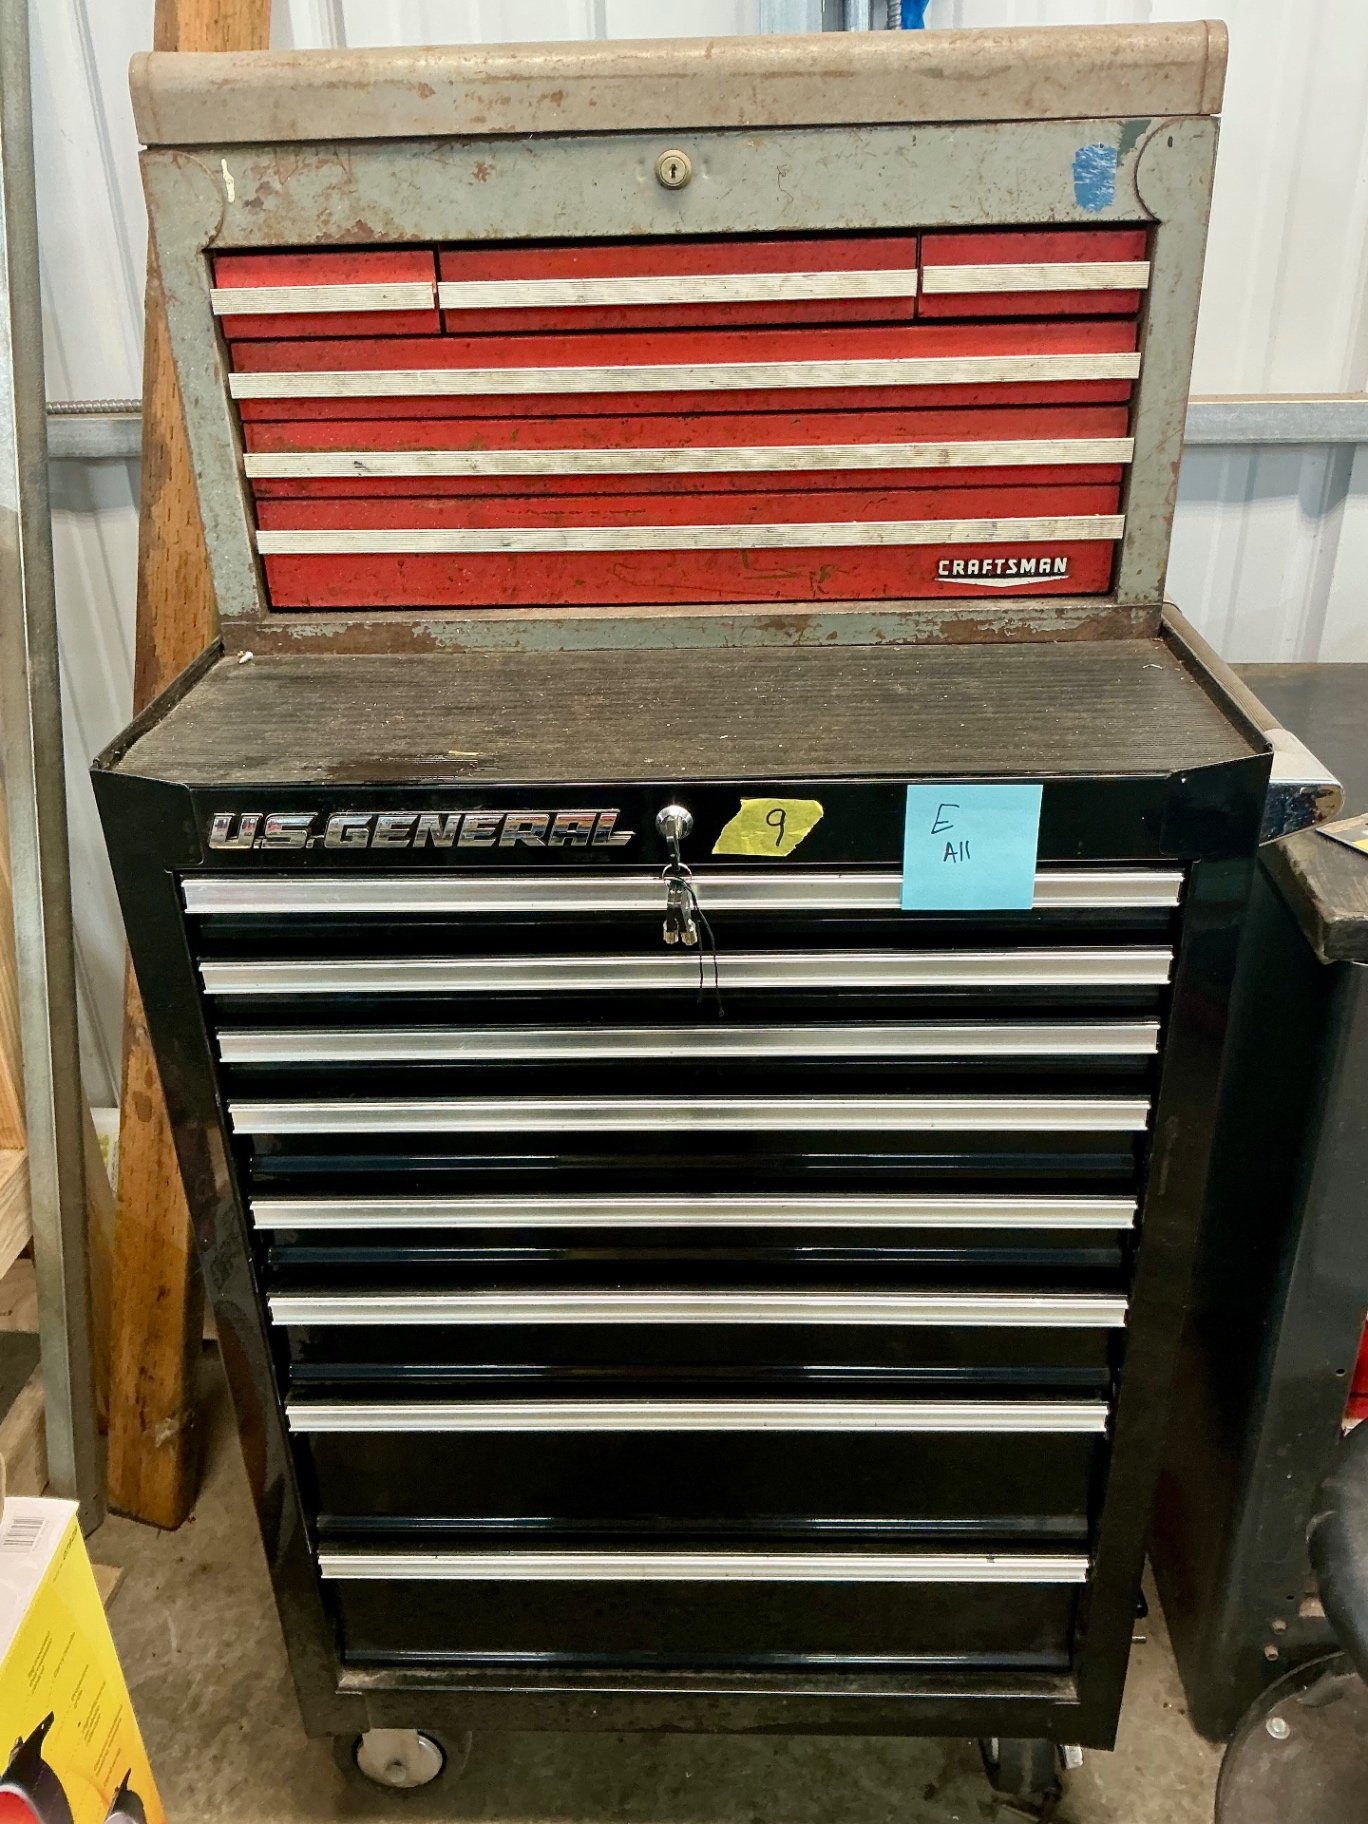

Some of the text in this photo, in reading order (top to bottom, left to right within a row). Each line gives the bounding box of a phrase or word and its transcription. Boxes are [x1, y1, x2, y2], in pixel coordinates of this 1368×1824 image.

[937, 557, 1068, 577] CRAFTSMAN
[765, 808, 787, 847] 9
[930, 803, 960, 835] E
[942, 840, 970, 863] All
